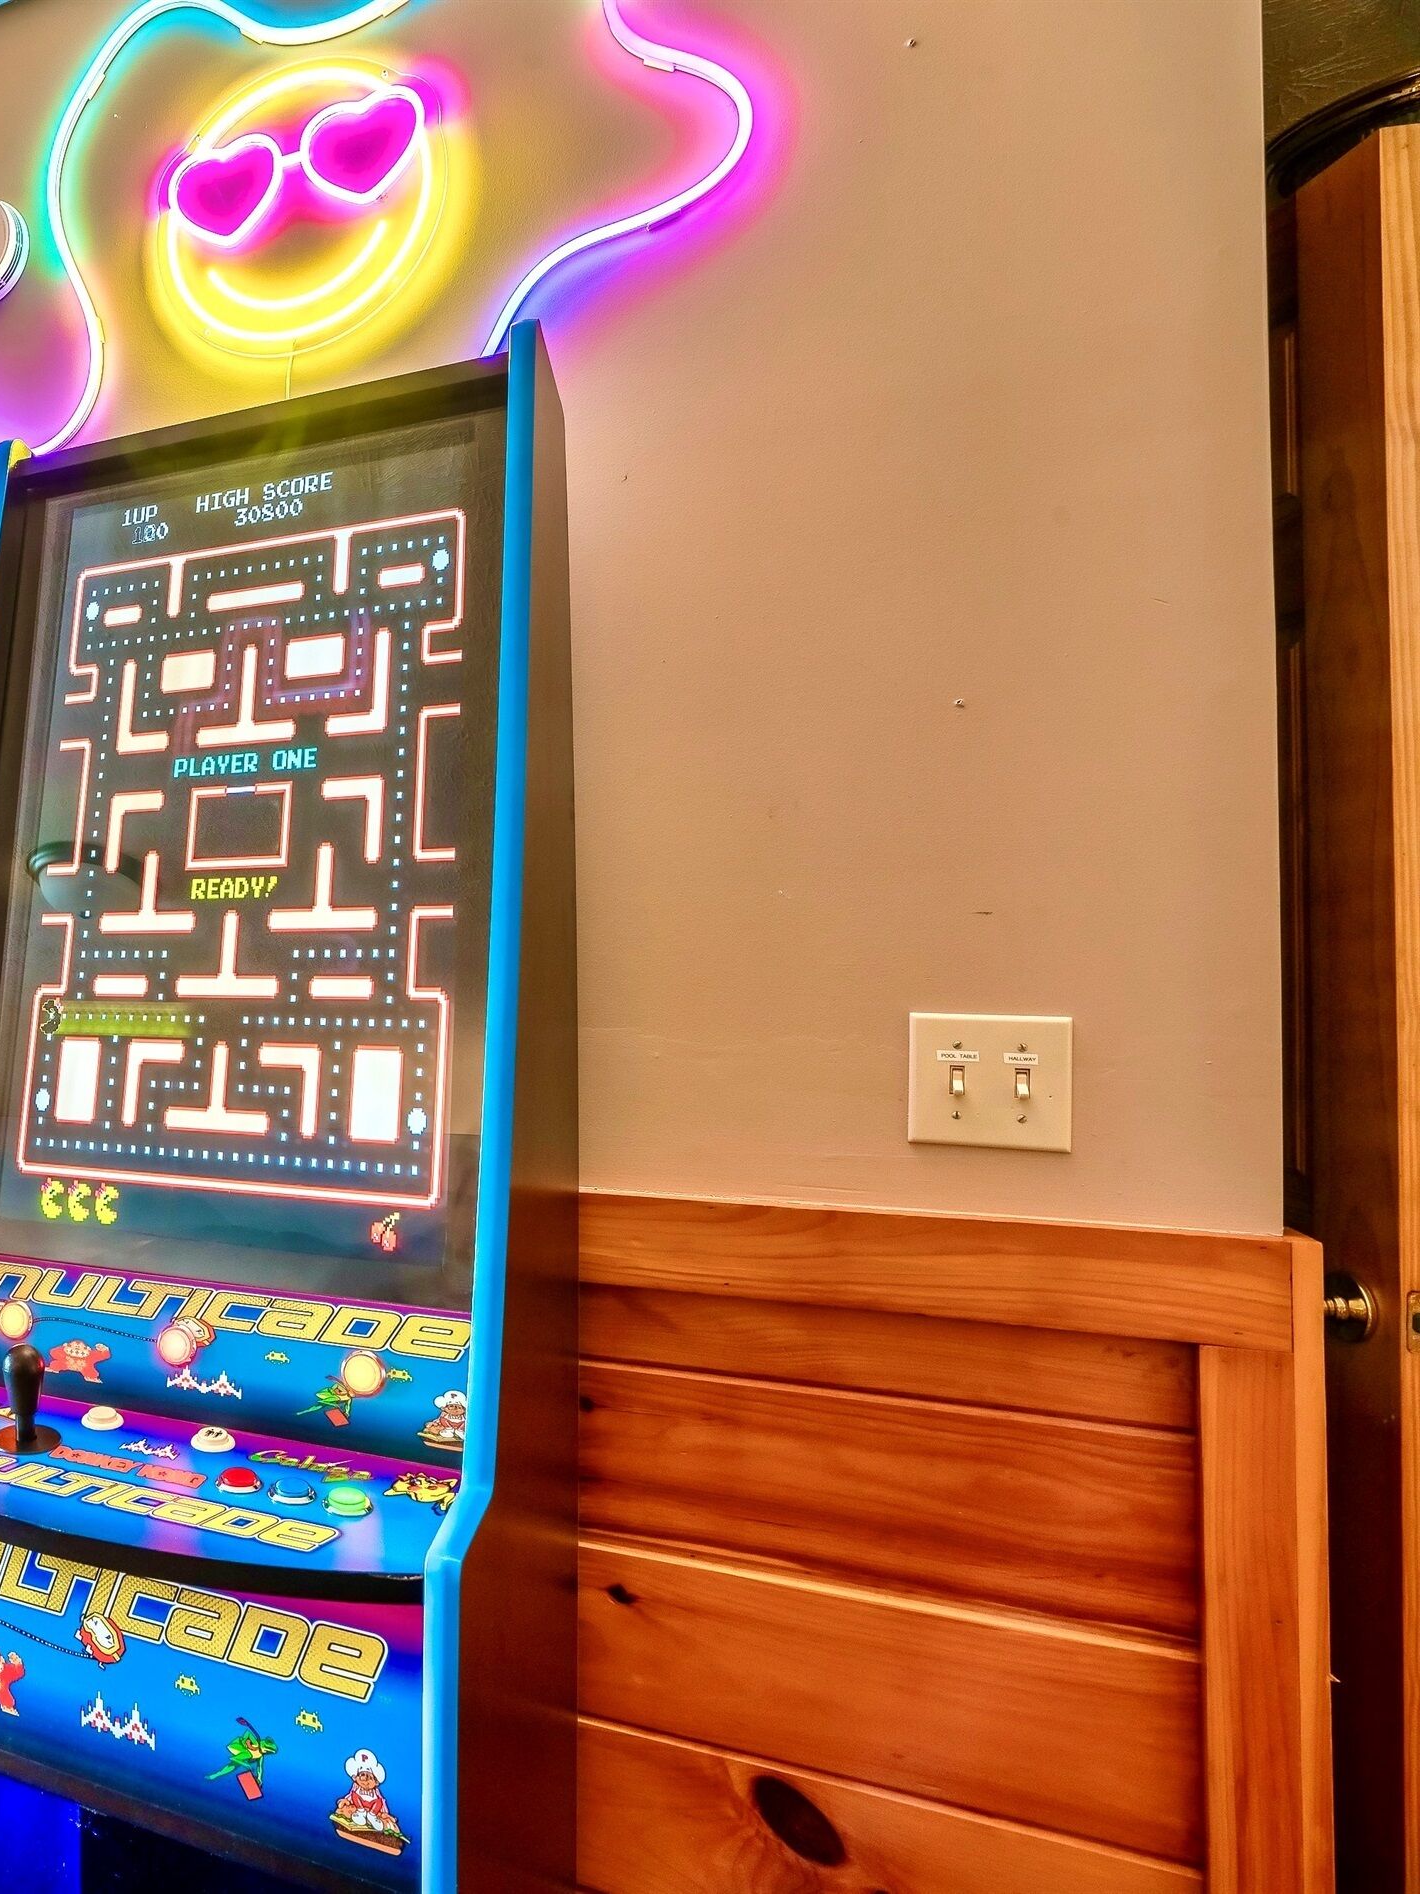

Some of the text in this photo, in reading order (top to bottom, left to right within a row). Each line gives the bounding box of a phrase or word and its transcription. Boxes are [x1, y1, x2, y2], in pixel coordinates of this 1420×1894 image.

[121, 471, 334, 527] 1UP HIGH SCORE
[234, 498, 304, 527] 30800
[173, 747, 318, 778] PLAYER ONE
[190, 876, 278, 900] READY!
[49, 1445, 141, 1474] DONKEY
